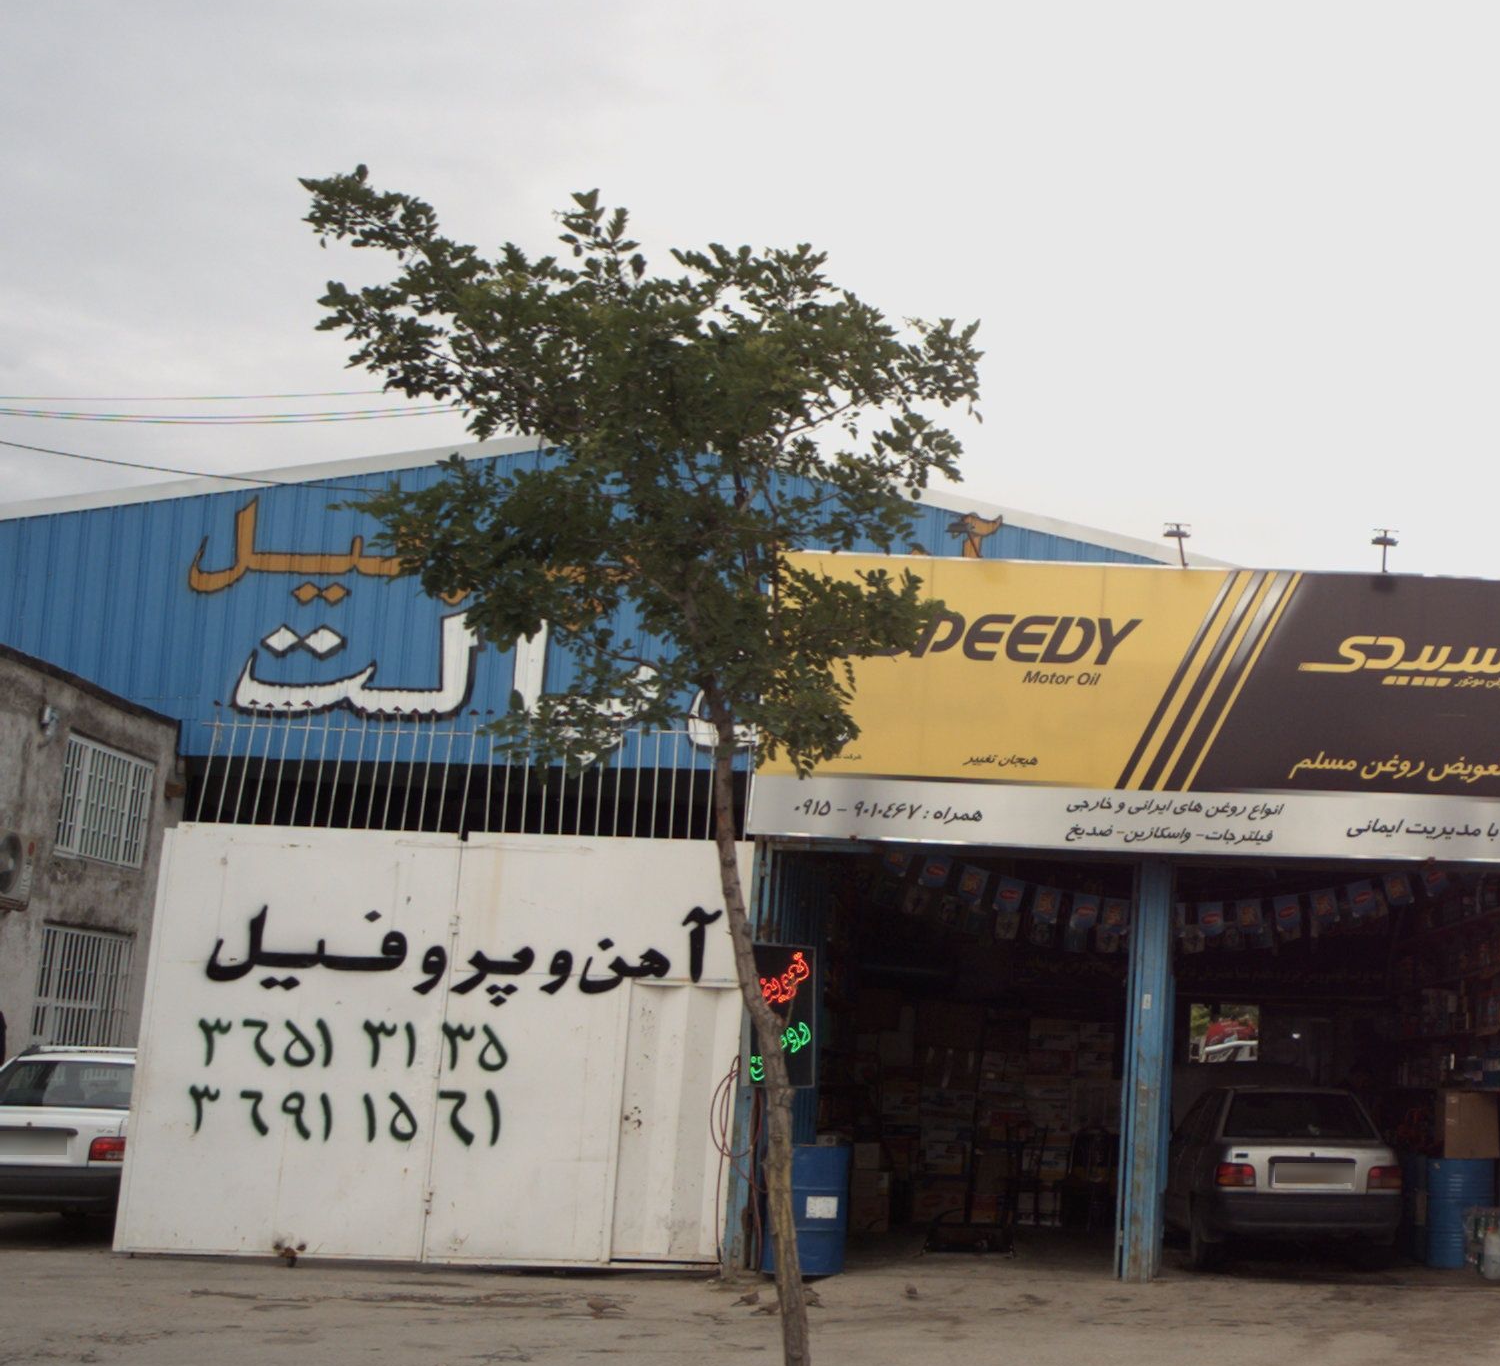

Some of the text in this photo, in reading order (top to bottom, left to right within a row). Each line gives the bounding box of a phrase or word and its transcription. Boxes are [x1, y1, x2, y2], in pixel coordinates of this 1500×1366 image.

[842, 611, 1143, 666] PEEDY
[1021, 670, 1101, 687] Motor Oil
[1454, 676, 1486, 688] موتور
[962, 753, 1039, 768] هیجان تغییر
[1288, 750, 1358, 780] مسلم
[1360, 754, 1426, 780] روغن
[934, 806, 984, 825] همراه
[1066, 797, 1285, 821] انواع روغن های ایرانی و خارجی
[1065, 822, 1113, 843] ضدیخ
[1346, 818, 1500, 842] با مدیریت ایمانی
[204, 902, 723, 1008] آهن و پروفیل
